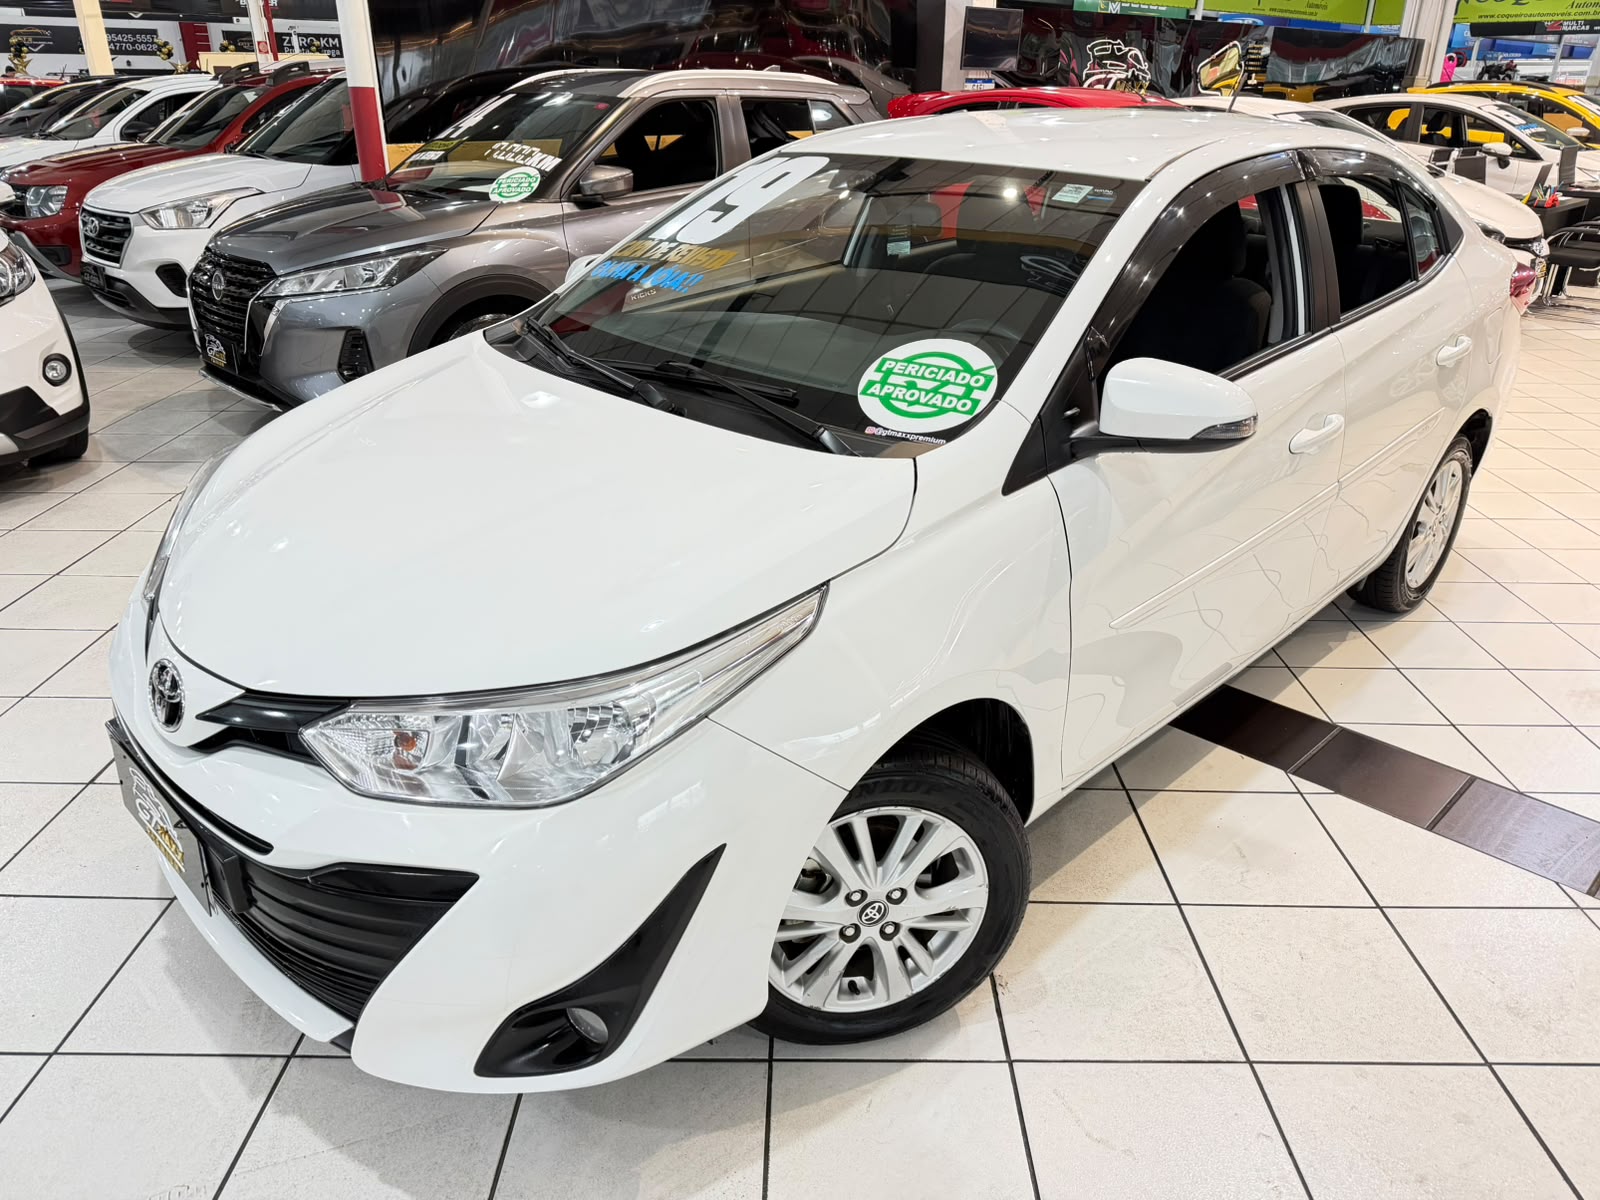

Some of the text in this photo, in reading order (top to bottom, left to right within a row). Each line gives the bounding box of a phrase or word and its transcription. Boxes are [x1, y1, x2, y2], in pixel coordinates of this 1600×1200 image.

[1478, 9, 1600, 19] www.coqueiroautomoveis.com.br
[320, 37, 339, 48] KM
[499, 176, 536, 184] PERICIADO
[493, 186, 532, 194] APROVADO
[648, 156, 830, 245] 19
[648, 241, 680, 259] DE
[664, 243, 738, 270] REVISTA
[591, 260, 638, 281] OLHA
[627, 264, 653, 282] A
[881, 360, 986, 387] PERICIADO
[867, 384, 972, 412] APROVADO
[875, 428, 947, 445] @gtmaxxpremium
